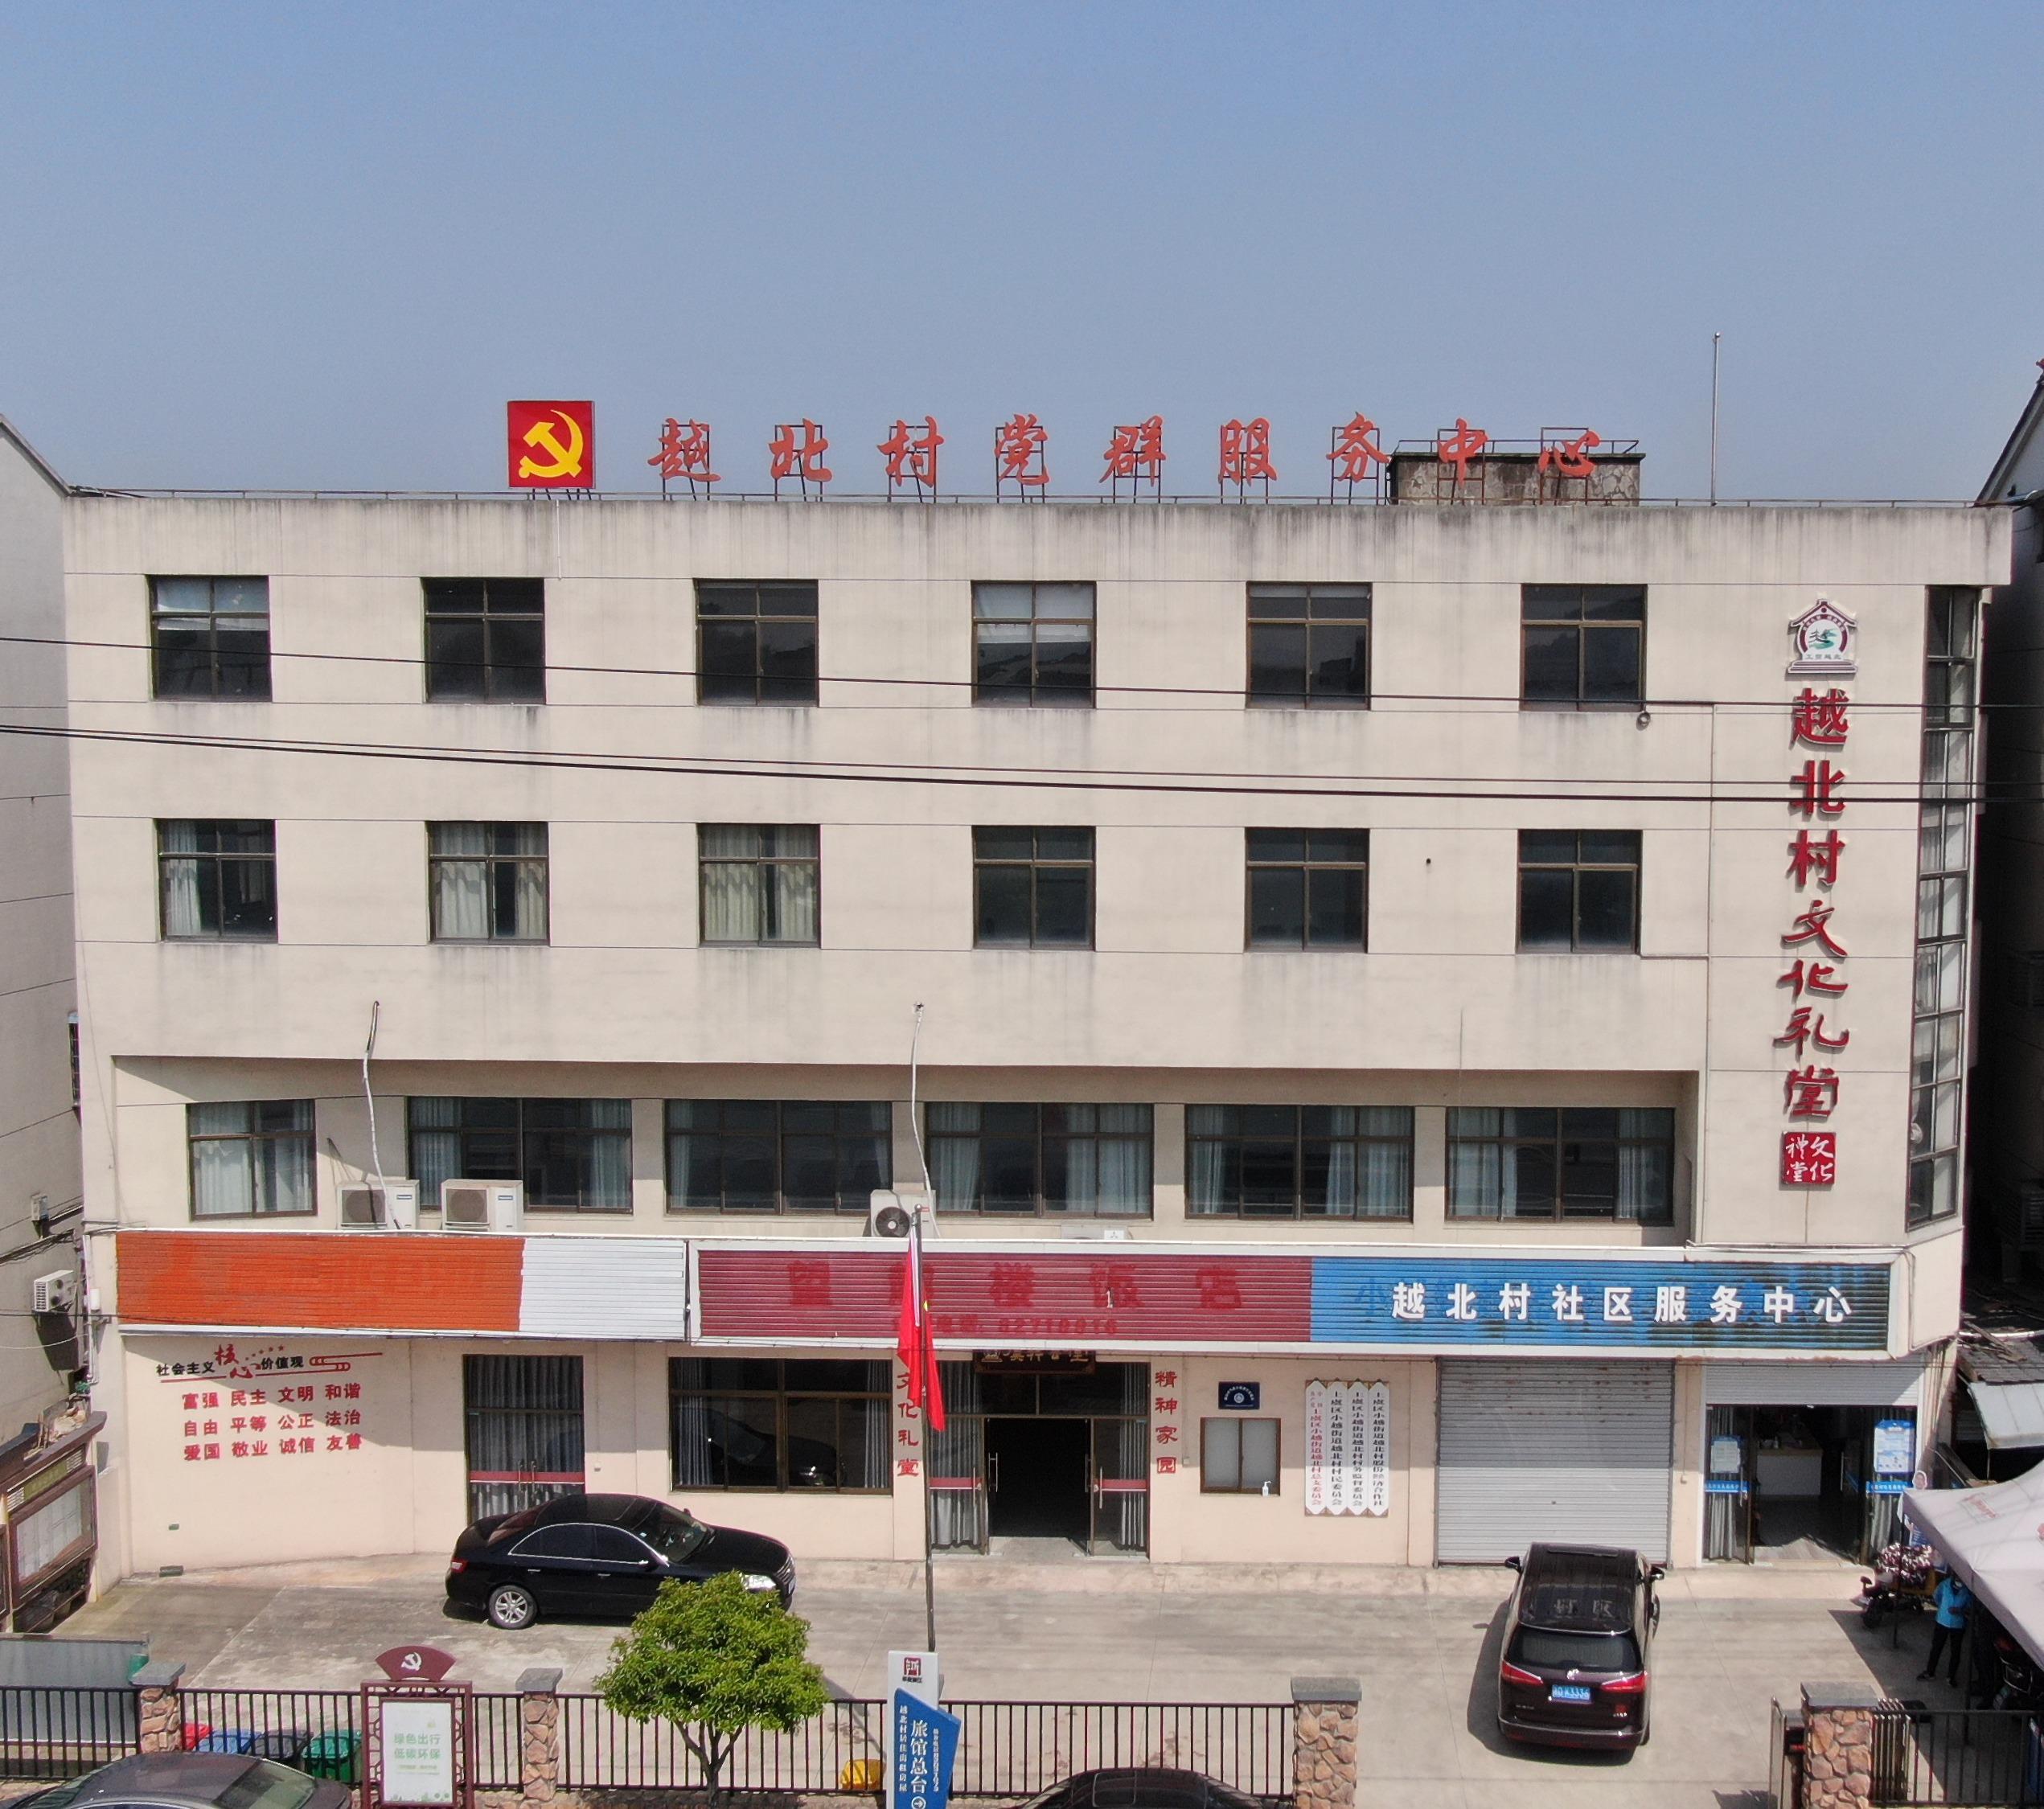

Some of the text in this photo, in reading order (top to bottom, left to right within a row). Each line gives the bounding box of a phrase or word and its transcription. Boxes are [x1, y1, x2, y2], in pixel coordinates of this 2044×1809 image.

[647, 411, 1600, 487] 越北村党群服务中心
[1773, 688, 1849, 1117] 越北村文化礼堂
[1392, 1282, 1852, 1323] 越北村社区服务中心
[156, 1361, 216, 1376] 社会主义
[261, 1356, 304, 1370] 价值观
[182, 1383, 361, 1410] 富强 民主 文明 和谐
[184, 1409, 361, 1438] 自由 平等 公正 法治
[1155, 1370, 1178, 1475] 精神家园
[183, 1433, 362, 1462] 爱国 敬业 诚信 友善
[394, 1733, 441, 1745] 绿色出行
[394, 1748, 441, 1760] 低碳环保
[910, 1719, 928, 1794] 旅馆总台
